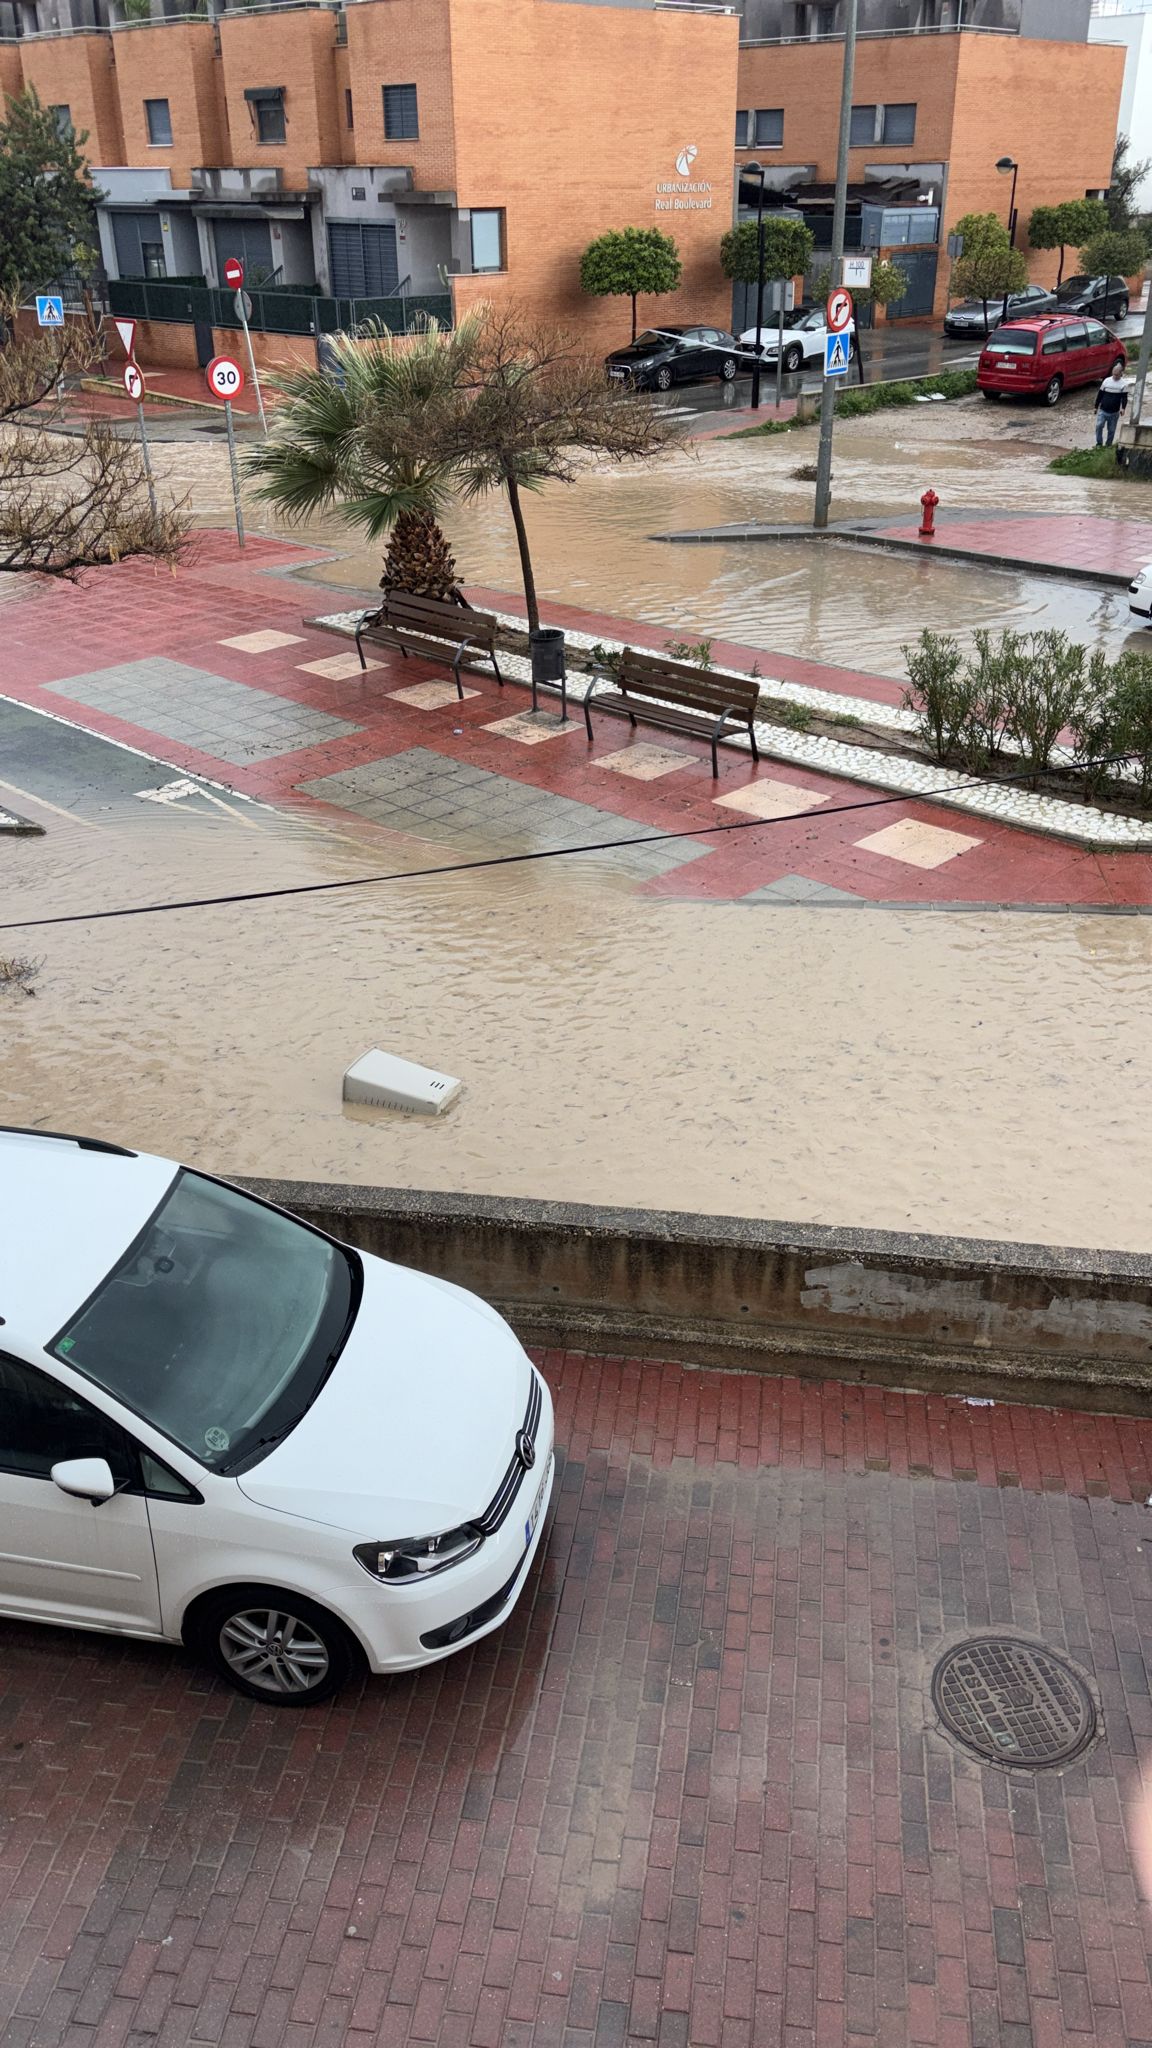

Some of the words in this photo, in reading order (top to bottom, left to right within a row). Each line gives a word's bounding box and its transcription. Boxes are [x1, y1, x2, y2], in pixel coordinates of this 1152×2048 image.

[656, 181, 712, 193] URBANIZACIÓN
[655, 198, 673, 210] Real
[675, 197, 712, 209] Boulevard
[217, 371, 236, 385] 30
